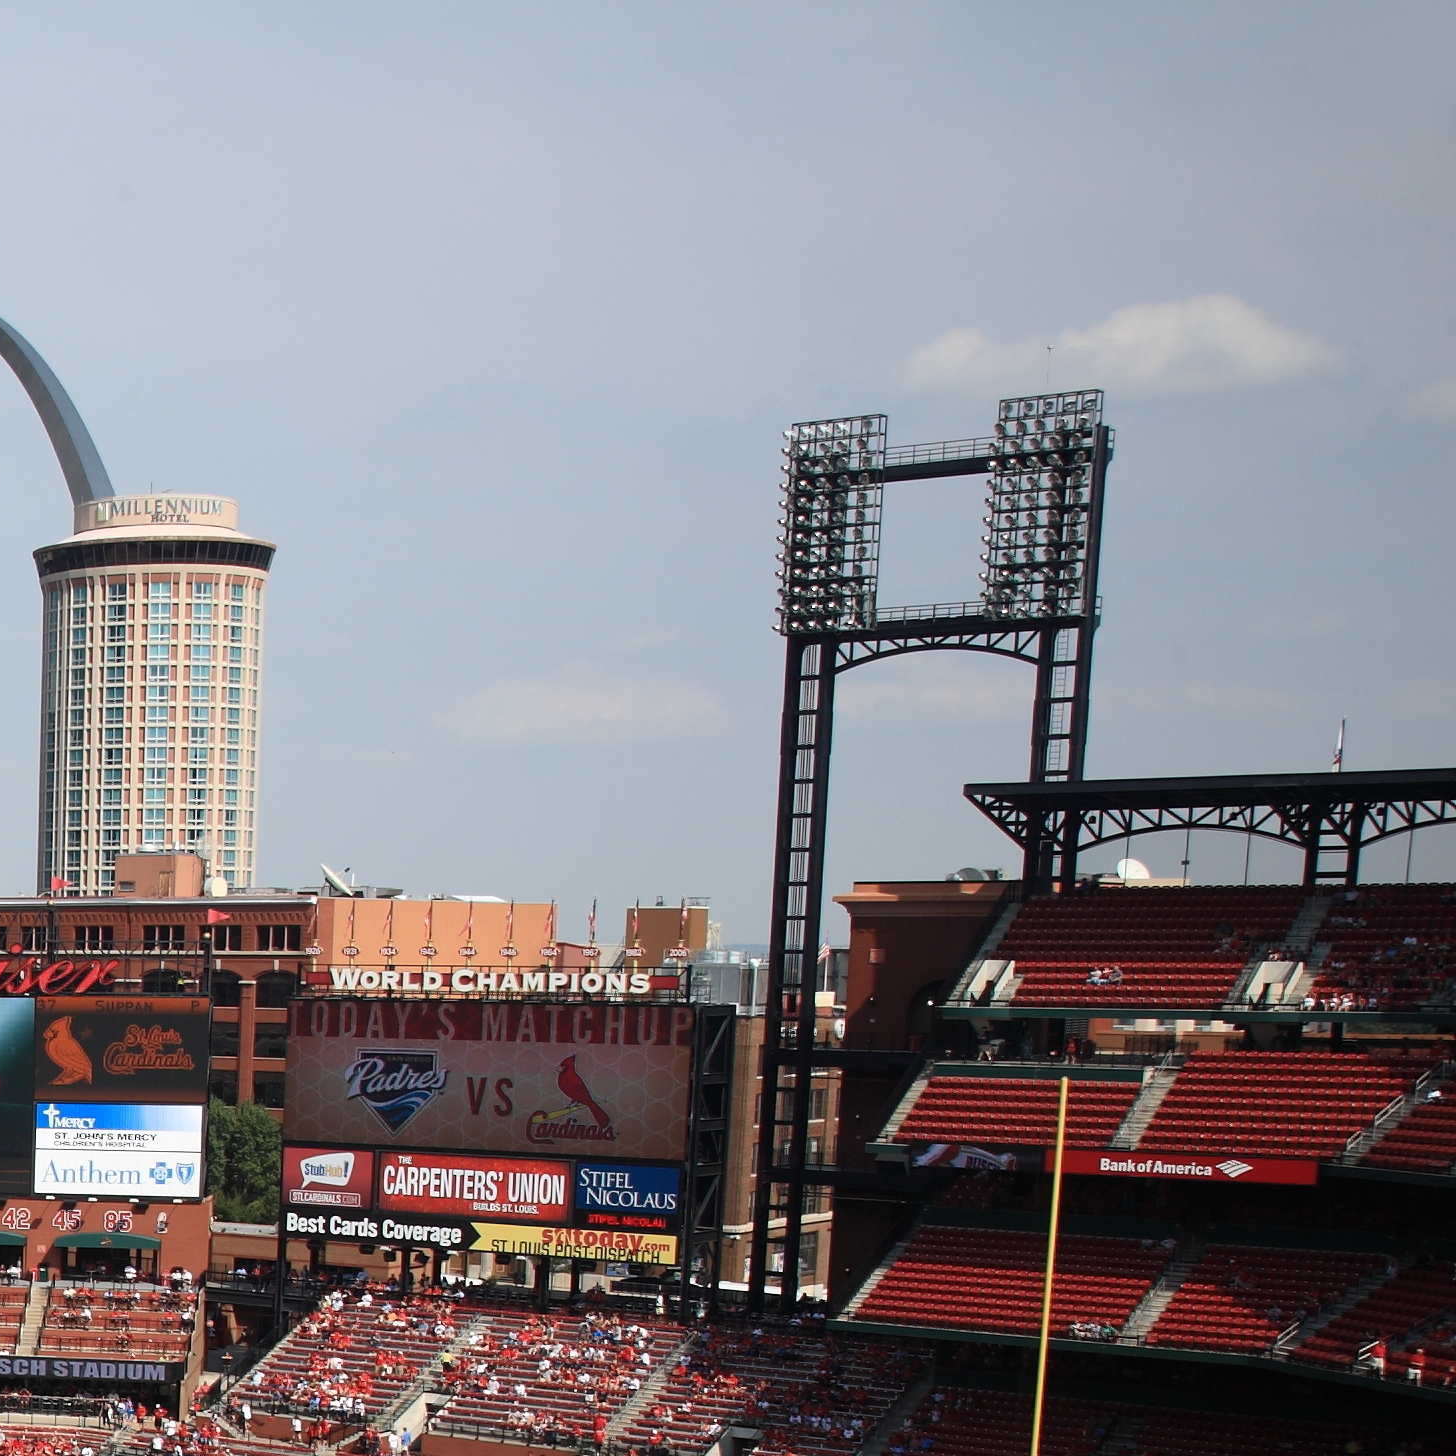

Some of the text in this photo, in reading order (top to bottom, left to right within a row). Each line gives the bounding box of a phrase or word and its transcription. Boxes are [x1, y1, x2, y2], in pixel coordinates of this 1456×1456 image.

[111, 498, 222, 517] MILLENNIUM
[150, 512, 189, 524] HOTEL
[330, 968, 651, 994] WORLD CHAMPIONS
[94, 1000, 153, 1013] SUPPAN
[290, 1001, 693, 1046] TODAY'S MATCHUP
[104, 1041, 195, 1075] Cardinals
[344, 1055, 449, 1100] Padres
[467, 1077, 513, 1117] VS
[54, 1117, 97, 1129] MERCY
[525, 1110, 617, 1144] Cardinals
[54, 1132, 158, 1141] ST. JOHN'S MERCY
[303, 1159, 350, 1178] StubHub!
[398, 1155, 412, 1165] THE
[1100, 1158, 1213, 1178] Bank of America
[41, 1159, 143, 1185] Anthem
[579, 1167, 633, 1189] STIFEL
[383, 1163, 565, 1205] CARPENTERS' UNION
[473, 1202, 501, 1213] BUILDS
[587, 1186, 677, 1211] NICOLAUS
[1, 1207, 31, 1230] 42
[52, 1209, 82, 1233] 45
[103, 1210, 133, 1233] 85
[286, 1211, 462, 1247] Best Cards Coverage
[52, 1358, 166, 1381] STADIUM
